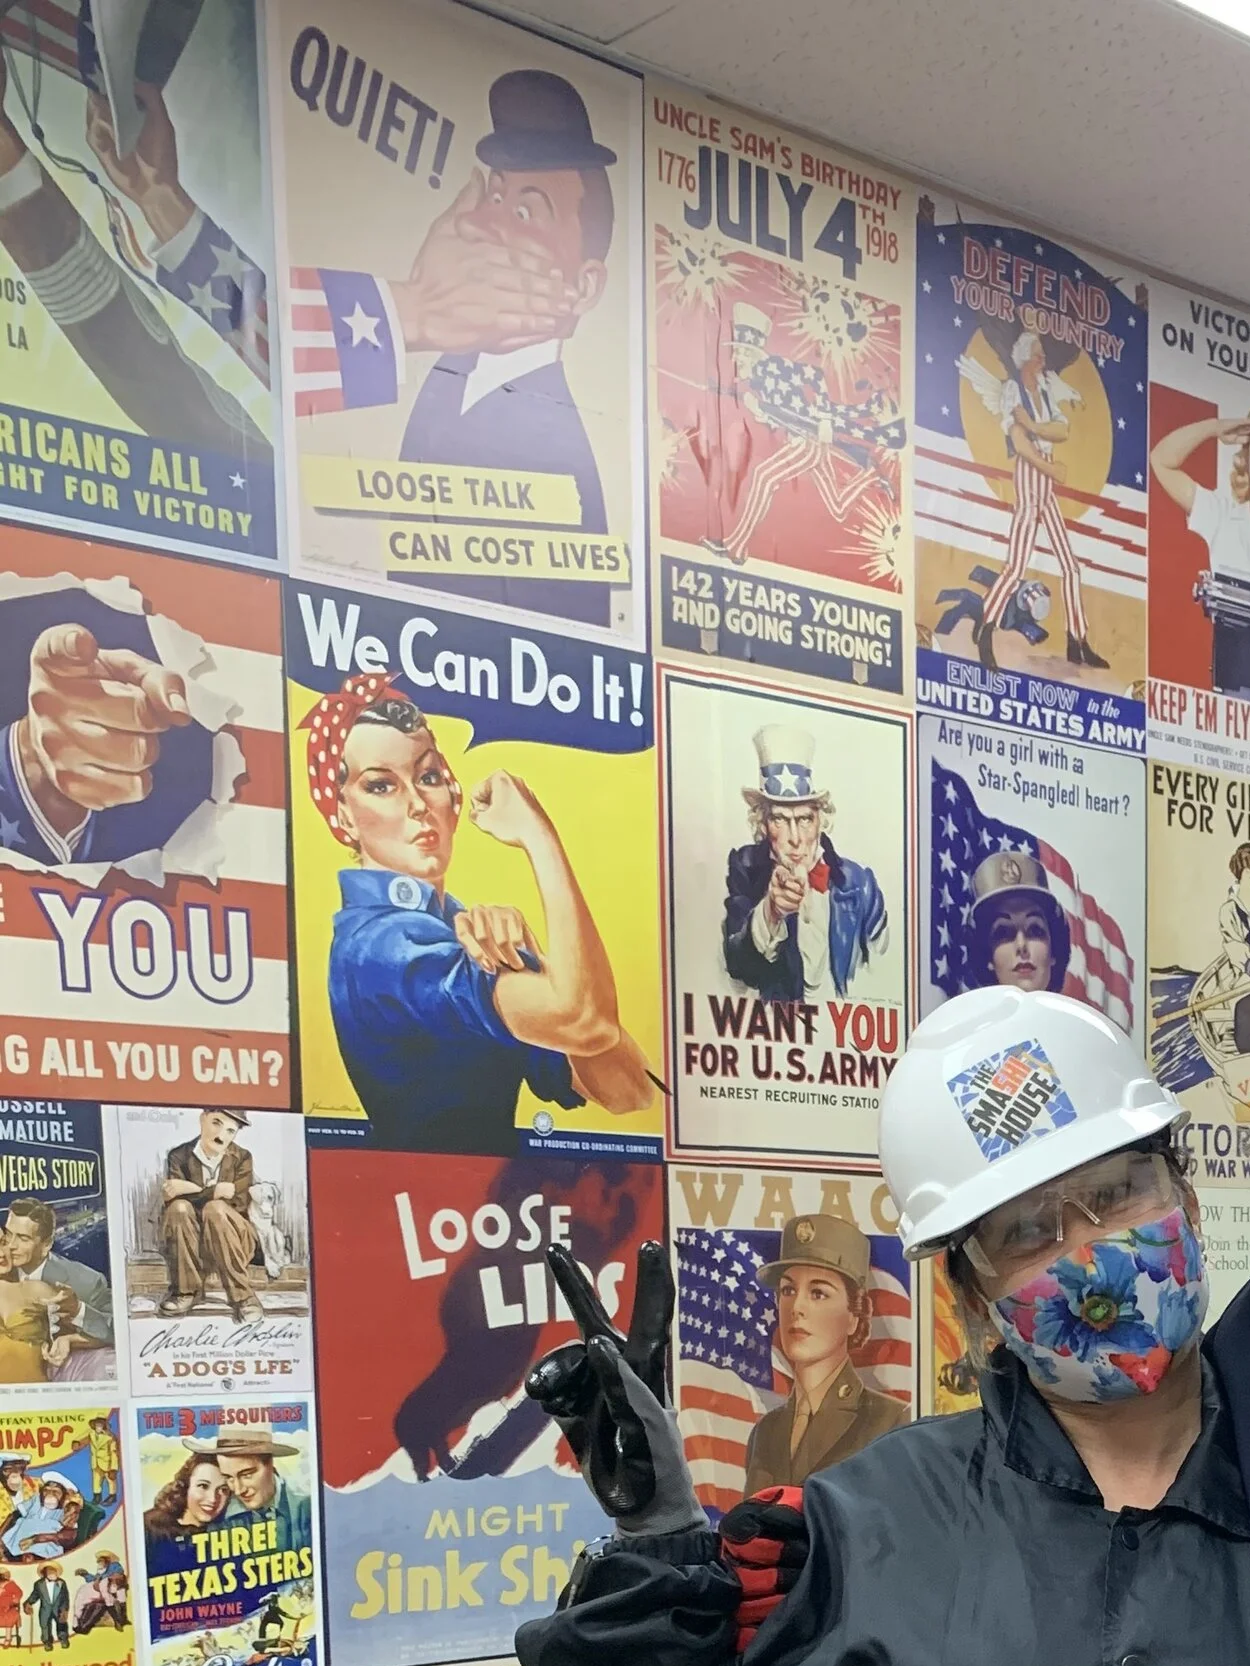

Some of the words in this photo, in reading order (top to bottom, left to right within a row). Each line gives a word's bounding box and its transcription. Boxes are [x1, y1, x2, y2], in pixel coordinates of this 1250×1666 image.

[290, 25, 455, 190] QUIET!
[653, 97, 721, 144] UNCLE
[729, 126, 793, 170] SAM'S
[801, 152, 902, 211] BIRTHDAY
[658, 147, 696, 193] 1776
[683, 145, 814, 263] JULY
[866, 224, 898, 264] 1918
[963, 236, 1111, 326] DEFEND
[7, 323, 29, 351] LA
[950, 275, 1015, 323] YOUR
[1019, 303, 1125, 362] COUNTRY
[1162, 323, 1194, 354] ON
[150, 447, 208, 496] ALL
[357, 469, 453, 504] LOOSE
[464, 477, 535, 511] TALK
[64, 475, 120, 511] FOR
[133, 489, 252, 537] VICTORY
[389, 531, 452, 562] CAN
[464, 536, 535, 567] COST
[671, 566, 714, 599] 142
[722, 576, 802, 618] YEARS
[809, 596, 892, 639] YOUNG
[672, 595, 720, 630] AND
[724, 608, 793, 645] GOING
[800, 624, 892, 668] STRONG!
[297, 593, 390, 673] We
[399, 617, 499, 700] Can
[511, 637, 581, 713] Do
[592, 654, 644, 727] It!
[947, 660, 1021, 698] ENLIST
[1028, 679, 1079, 711] NOW
[1087, 698, 1099, 713] in
[1101, 698, 1120, 719] the
[1148, 681, 1187, 726] KEEP
[1192, 689, 1217, 734] 'EM
[917, 678, 994, 716] UNITED
[1000, 699, 1084, 738] STATES
[1088, 719, 1145, 750] ARMY
[938, 719, 963, 747] Are
[967, 731, 992, 757] you
[996, 741, 1005, 756] a
[1010, 736, 1034, 766] girl
[1038, 744, 1068, 771] with
[1153, 765, 1219, 805] EVERY
[1223, 760, 1245, 773] SERVICE
[1167, 799, 1214, 834] FOR
[30, 887, 254, 1005] YOU
[683, 992, 694, 1036] I
[707, 994, 819, 1046] WANT
[826, 1000, 898, 1054] YOU
[40, 1036, 103, 1079] ALL
[106, 1041, 181, 1082] YOU
[191, 1045, 284, 1087] CAN?
[684, 1042, 739, 1078] FOR
[970, 1064, 996, 1091] THE
[700, 1086, 759, 1101] NEAREST
[765, 1089, 838, 1106] RECRUITING
[995, 1071, 1058, 1146] HOUSE
[0, 1119, 74, 1142] MATURE
[529, 1138, 543, 1148] WAR
[544, 1139, 580, 1150] PRODUCTION
[625, 1144, 658, 1155] COMMITTEE
[0, 1155, 48, 1192] VEGAS
[52, 1158, 95, 1189] STORY
[1205, 1159, 1236, 1178] WAR
[394, 1191, 573, 1280] LOOSE
[1209, 1256, 1249, 1271] School
[139, 1323, 219, 1358] Charlie
[172, 1360, 246, 1378] DOG'S
[38, 1414, 85, 1424] TALKING
[143, 1411, 174, 1429] THE
[178, 1408, 197, 1436] 3
[0, 1425, 74, 1458] IMPS
[424, 1503, 570, 1540] MIGHT
[149, 1562, 238, 1608] TEXAS
[242, 1547, 313, 1590] STERS
[350, 1549, 490, 1620] Sink
[160, 1606, 193, 1623] JOHN
[197, 1601, 243, 1618] WAYNE
